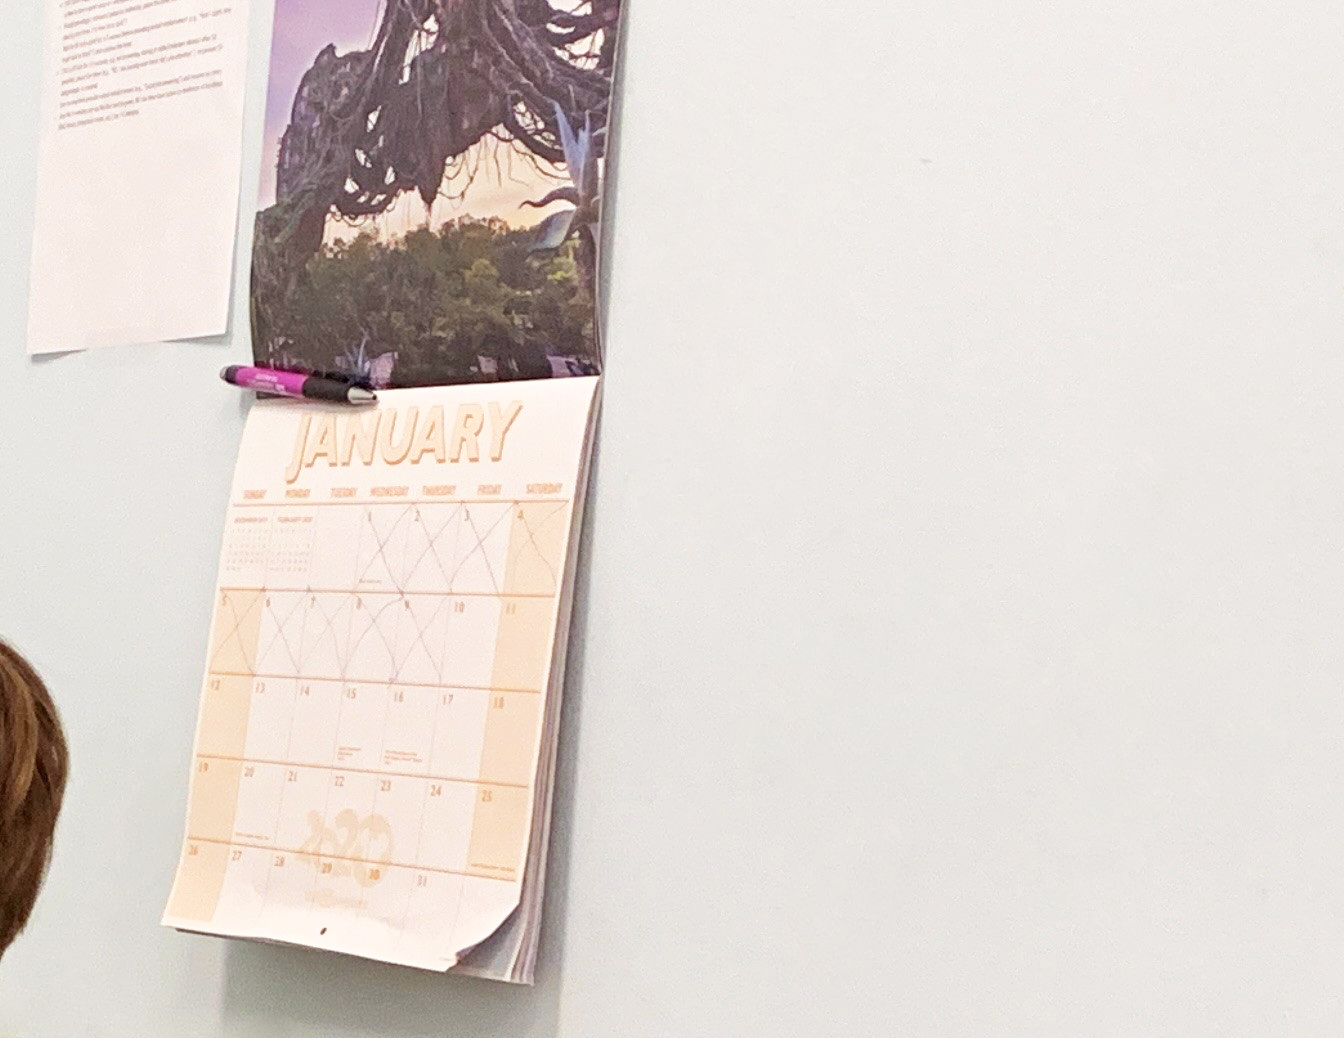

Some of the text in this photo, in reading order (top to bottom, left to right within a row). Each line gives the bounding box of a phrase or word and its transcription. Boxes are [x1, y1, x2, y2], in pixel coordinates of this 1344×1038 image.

[285, 400, 524, 485] JANUARY
[454, 601, 465, 613] 10
[300, 686, 310, 697] 14
[346, 688, 356, 699] 15
[394, 691, 404, 702] 16
[443, 694, 454, 705] 17
[288, 770, 298, 782] 21
[334, 775, 345, 787] 22
[380, 780, 392, 792] 23
[430, 784, 442, 796] 24
[481, 790, 493, 802] 25
[232, 850, 242, 862] 27
[273, 856, 285, 867] 28
[417, 874, 427, 887] 31
